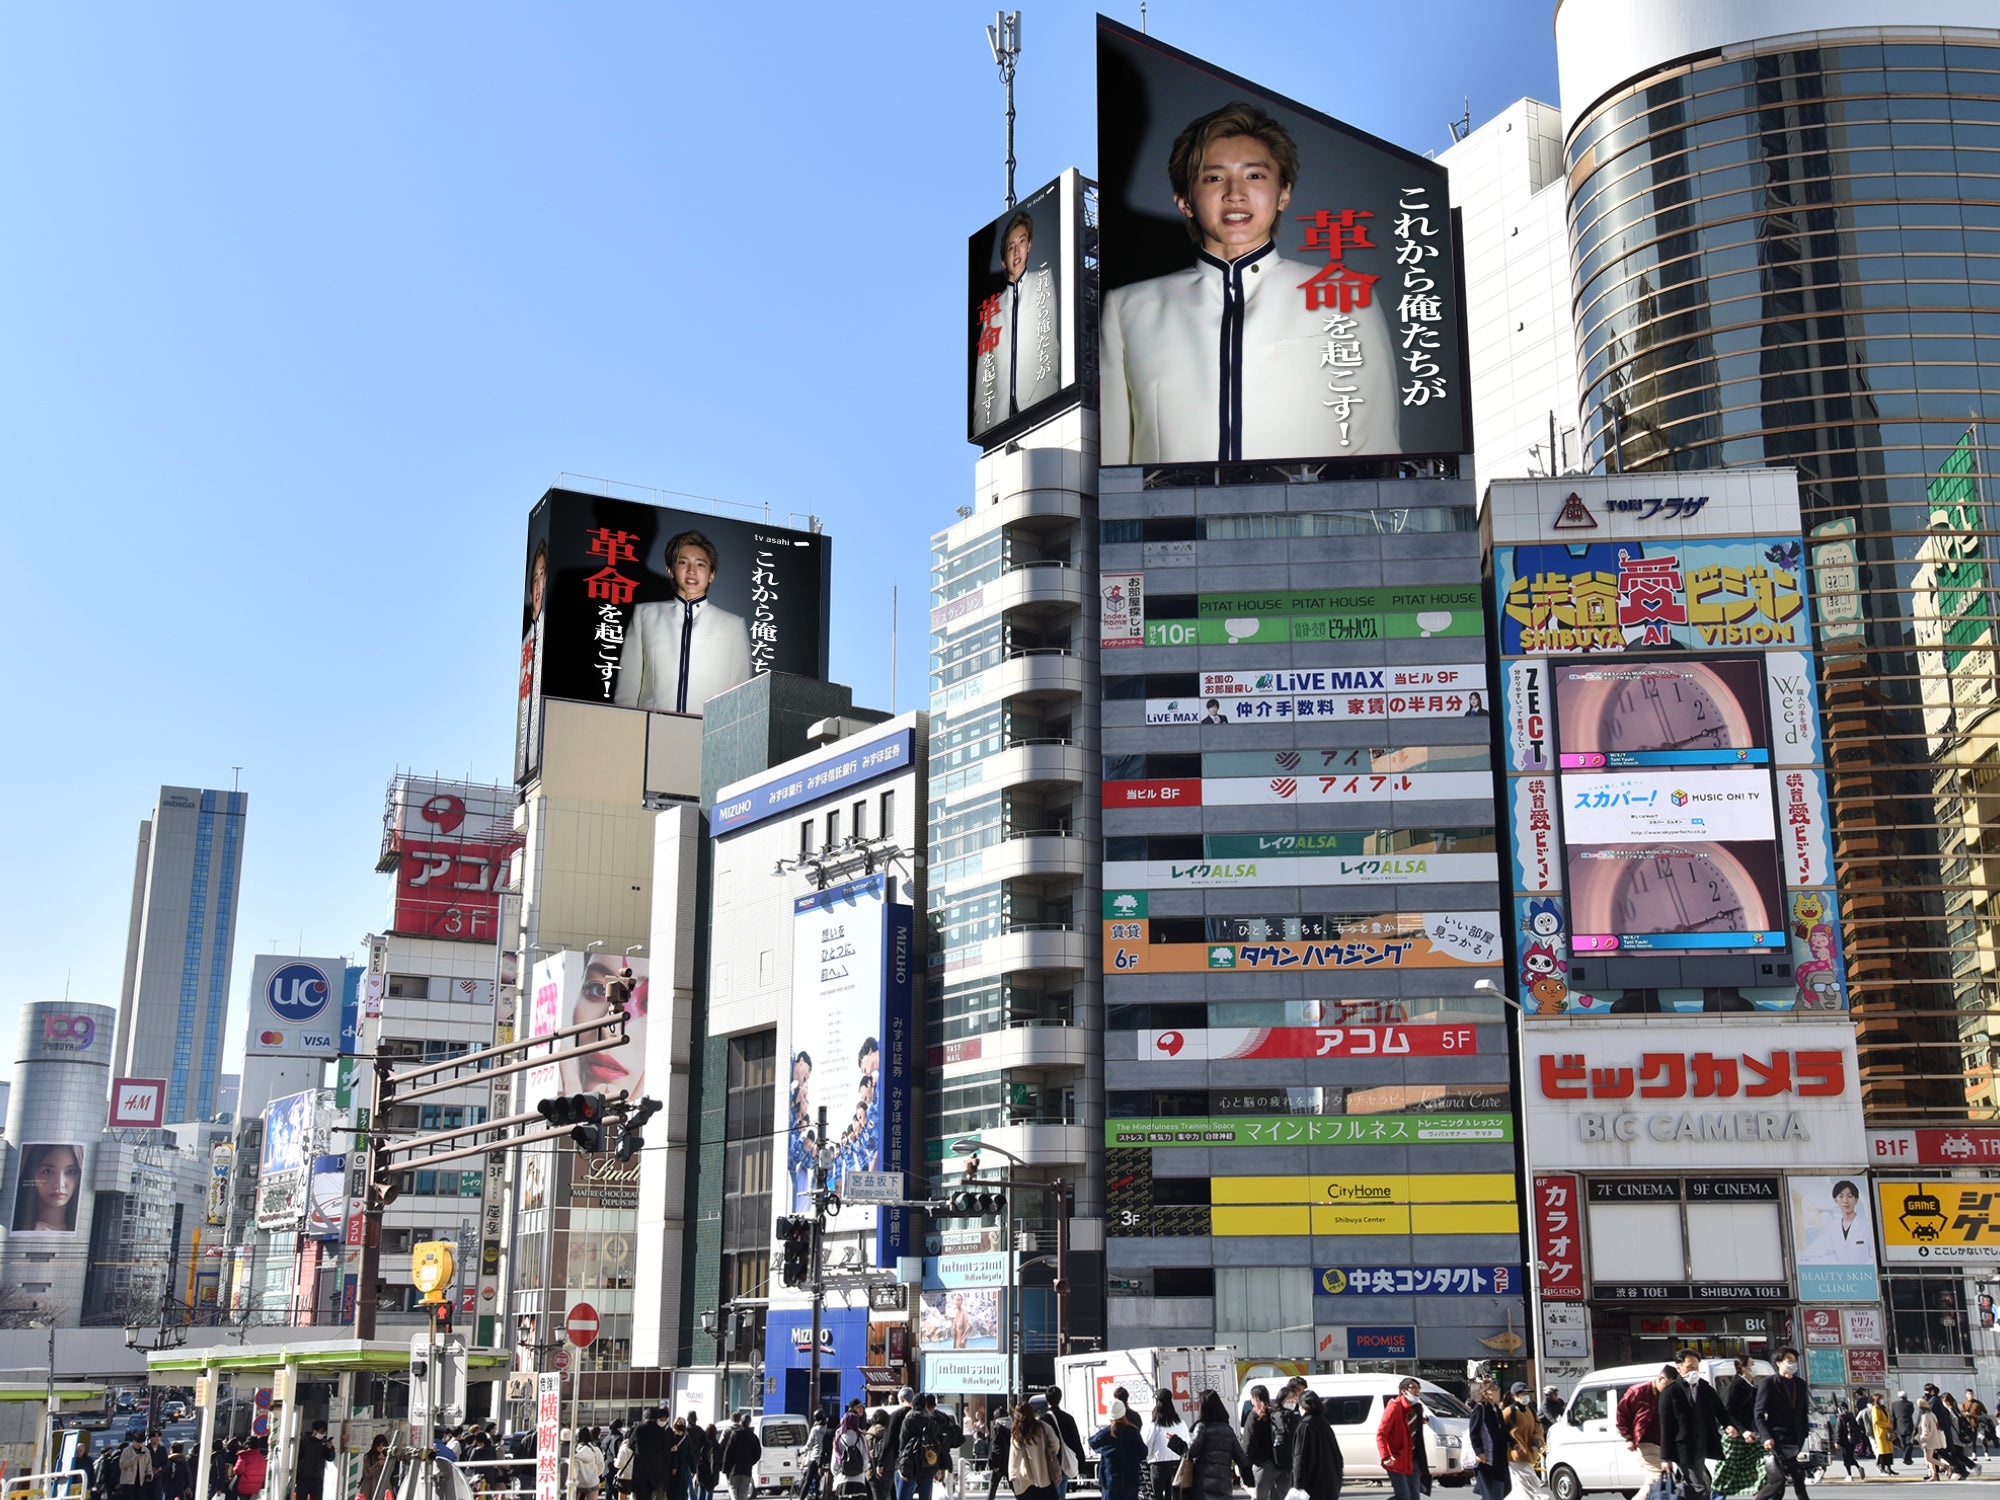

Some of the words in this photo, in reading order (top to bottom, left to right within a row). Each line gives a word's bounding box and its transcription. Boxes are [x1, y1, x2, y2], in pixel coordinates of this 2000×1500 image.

[1393, 187, 1447, 406] これから俺たちが
[1036, 261, 1051, 382] これから俺たちが
[754, 533, 763, 542] tv
[766, 536, 790, 547] asahi
[1128, 577, 1142, 636] お部屋探しは
[1200, 601, 1233, 612] PITAT
[1238, 599, 1282, 610] HOUSE
[1292, 598, 1326, 609] PITAT
[1330, 596, 1375, 607] HOUSE
[1392, 594, 1427, 605] PITAT
[1431, 592, 1476, 604] HOUSE
[1157, 624, 1196, 644] 10F
[1519, 626, 1628, 651] SHIBUYA
[1642, 625, 1671, 646] AI
[1697, 622, 1794, 646] VISION
[1205, 674, 1234, 684] 全国の
[1332, 671, 1385, 689] MAX
[1395, 673, 1434, 685] 当ビル
[1437, 671, 1459, 683] 9F
[1205, 684, 1253, 694] お部屋探し
[1236, 699, 1334, 718] 仲介手数料
[1347, 695, 1463, 714] 家賃の半月分
[1771, 676, 1800, 745] Weed
[1173, 712, 1199, 722] MAX
[1526, 668, 1544, 763] ZECT
[1319, 775, 1412, 793] アイフル
[1127, 789, 1157, 800] 当ビル
[1161, 787, 1180, 800] 8F
[1574, 789, 1658, 809] スカパー!
[1692, 793, 1723, 802] MUSIC
[1726, 792, 1745, 801] ON!
[1749, 792, 1760, 800] TV
[162, 800, 196, 810] INDIGO
[719, 799, 752, 822] MIZUHO
[1171, 863, 1257, 878] レイクALSA
[1340, 859, 1428, 875] レイクALSA
[444, 907, 490, 934] 3F
[1445, 915, 1496, 945] いい部屋
[895, 925, 908, 984] MIZUHO
[1115, 948, 1139, 969] 6F
[1239, 943, 1414, 967] タウンハウジング
[273, 978, 326, 1008] UC
[42, 1014, 96, 1050] 109
[304, 1035, 331, 1047] VISA
[1316, 1027, 1410, 1056] アコム
[1442, 1031, 1471, 1049] 5F
[1539, 1051, 1845, 1099] ビックカメラ
[1132, 1122, 1178, 1130] Mindfulness
[1181, 1122, 1211, 1131] Training
[1213, 1122, 1236, 1131] Space
[1245, 1120, 1409, 1141] マインドフルネス
[1579, 1111, 1640, 1143] BIC
[1650, 1110, 1810, 1142] CAMERA
[1876, 1139, 1910, 1156] B1F
[489, 1167, 504, 1177] 3F
[852, 1175, 899, 1187] 宮益坂下
[1536, 1179, 1548, 1187] 6F
[1694, 1183, 1710, 1195] 9F
[1714, 1183, 1772, 1195] CINEMA
[1327, 1183, 1391, 1198] CityHome
[1597, 1184, 1613, 1196] 7F
[1617, 1183, 1674, 1196] CINEMA
[601, 1199, 627, 1207] DEPUIS
[1121, 1210, 1141, 1226] 3F
[1335, 1216, 1362, 1224] Shibuya
[1363, 1215, 1386, 1223] Center
[1545, 1185, 1573, 1283] カラオケ
[1349, 1268, 1487, 1293] 中央コンタクト
[1493, 1267, 1509, 1293] 2F
[1801, 1271, 1842, 1281] BEAUTY
[1846, 1271, 1873, 1281] SKIN
[1616, 1288, 1637, 1298] 渋谷
[1642, 1287, 1668, 1298] TOEI
[1700, 1287, 1751, 1297] SHIBUYA
[1755, 1287, 1781, 1297] TOEI
[1818, 1283, 1859, 1293] CLINIC
[1357, 1335, 1406, 1347] PROMISE
[866, 1372, 894, 1382] WINE
